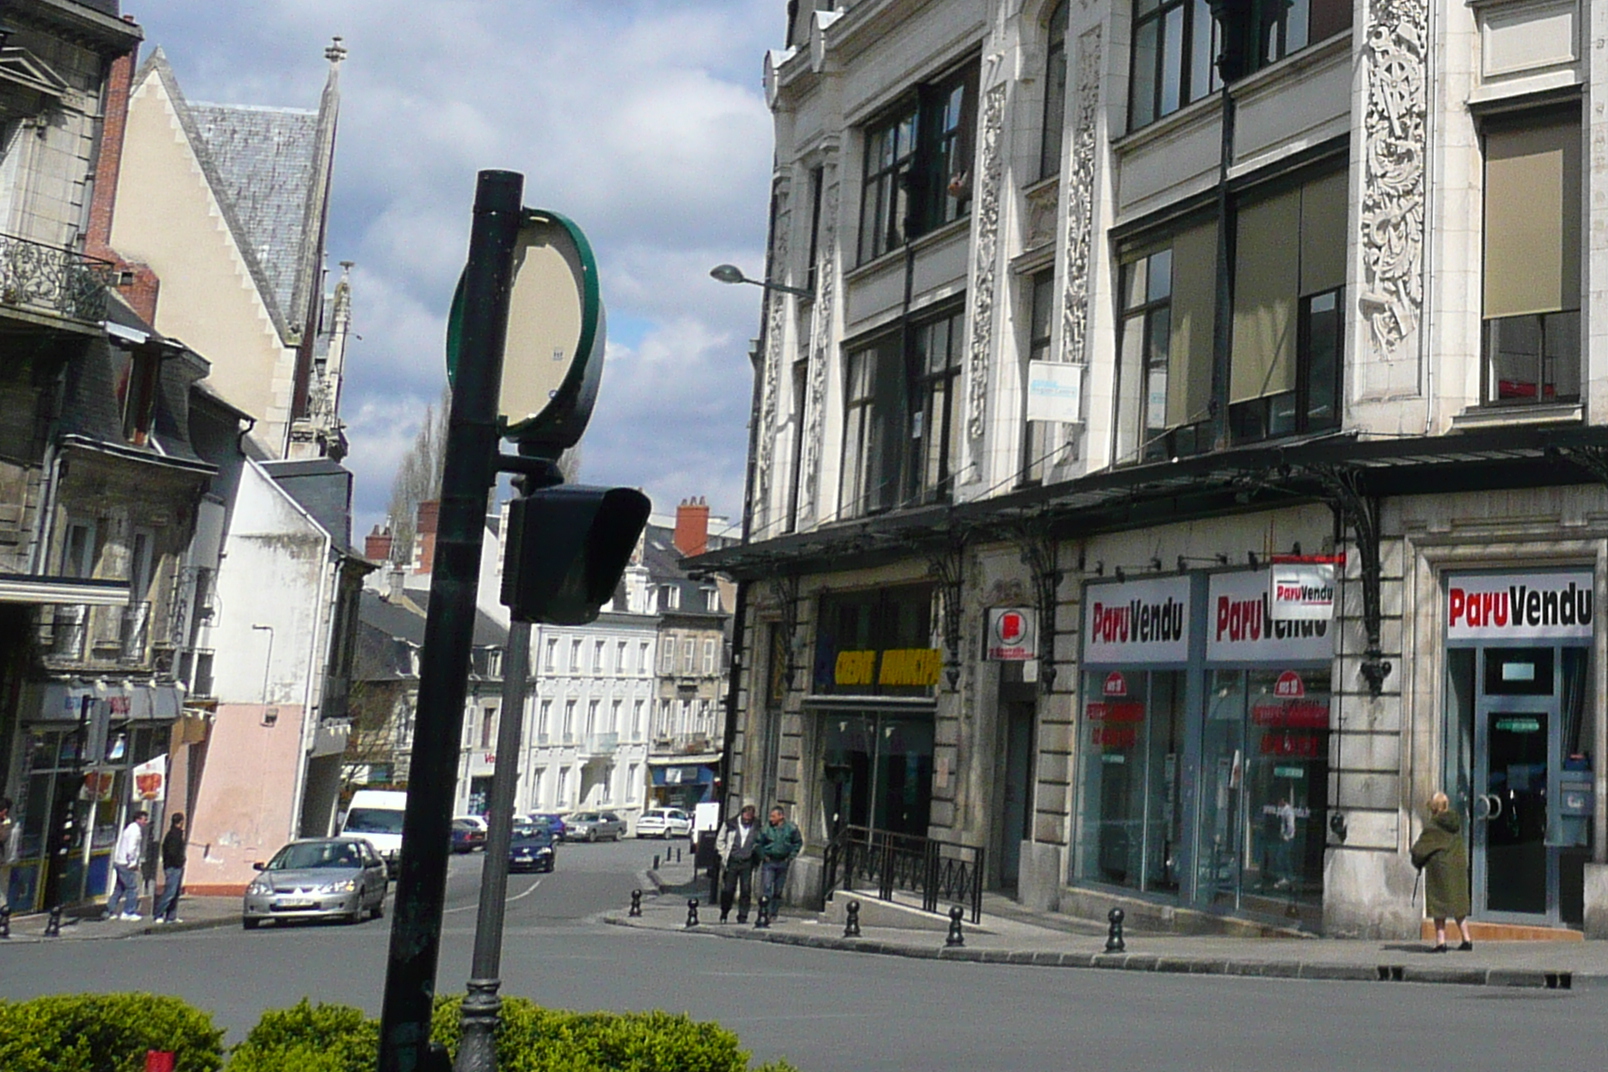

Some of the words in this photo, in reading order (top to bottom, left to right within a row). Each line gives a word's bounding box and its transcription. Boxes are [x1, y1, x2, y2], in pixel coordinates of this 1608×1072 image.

[1276, 584, 1333, 602] ParuVendu
[1449, 581, 1593, 628] ParuVendu
[1092, 597, 1184, 644] ParuVendu
